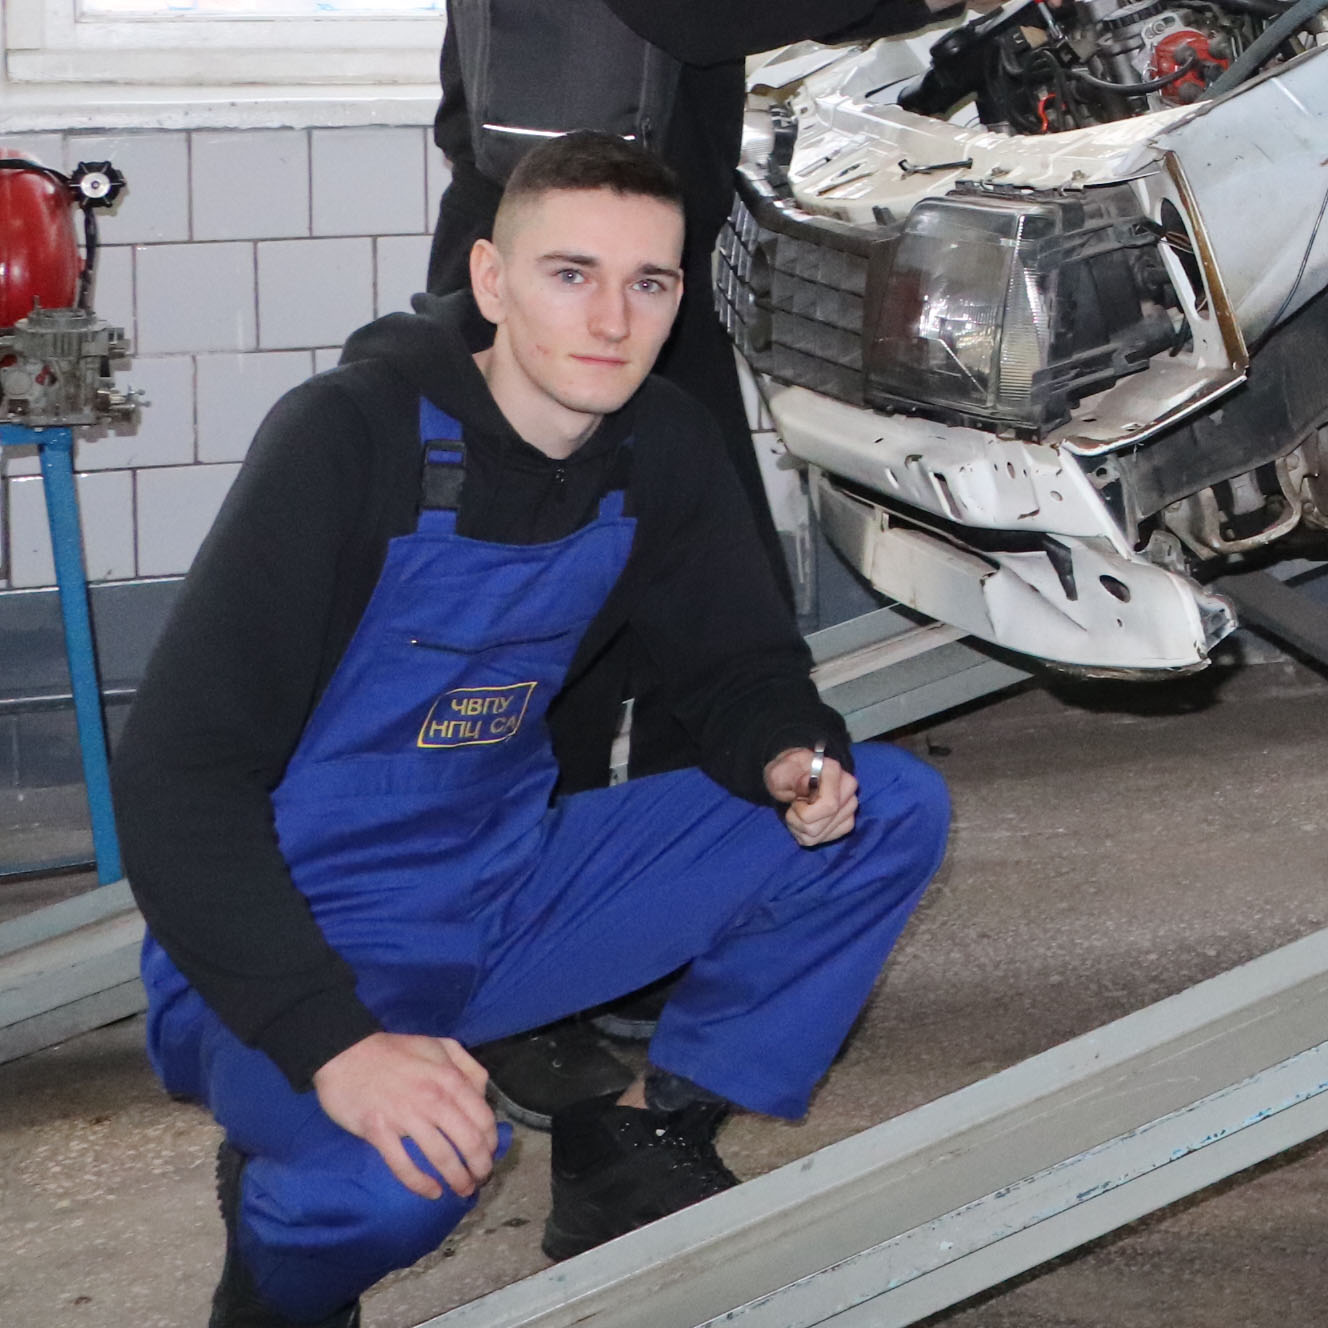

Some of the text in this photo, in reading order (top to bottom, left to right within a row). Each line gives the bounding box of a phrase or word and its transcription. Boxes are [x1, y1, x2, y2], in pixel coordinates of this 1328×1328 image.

[451, 695, 514, 715] ЧВПУ
[429, 716, 518, 739] НПЦ СА
